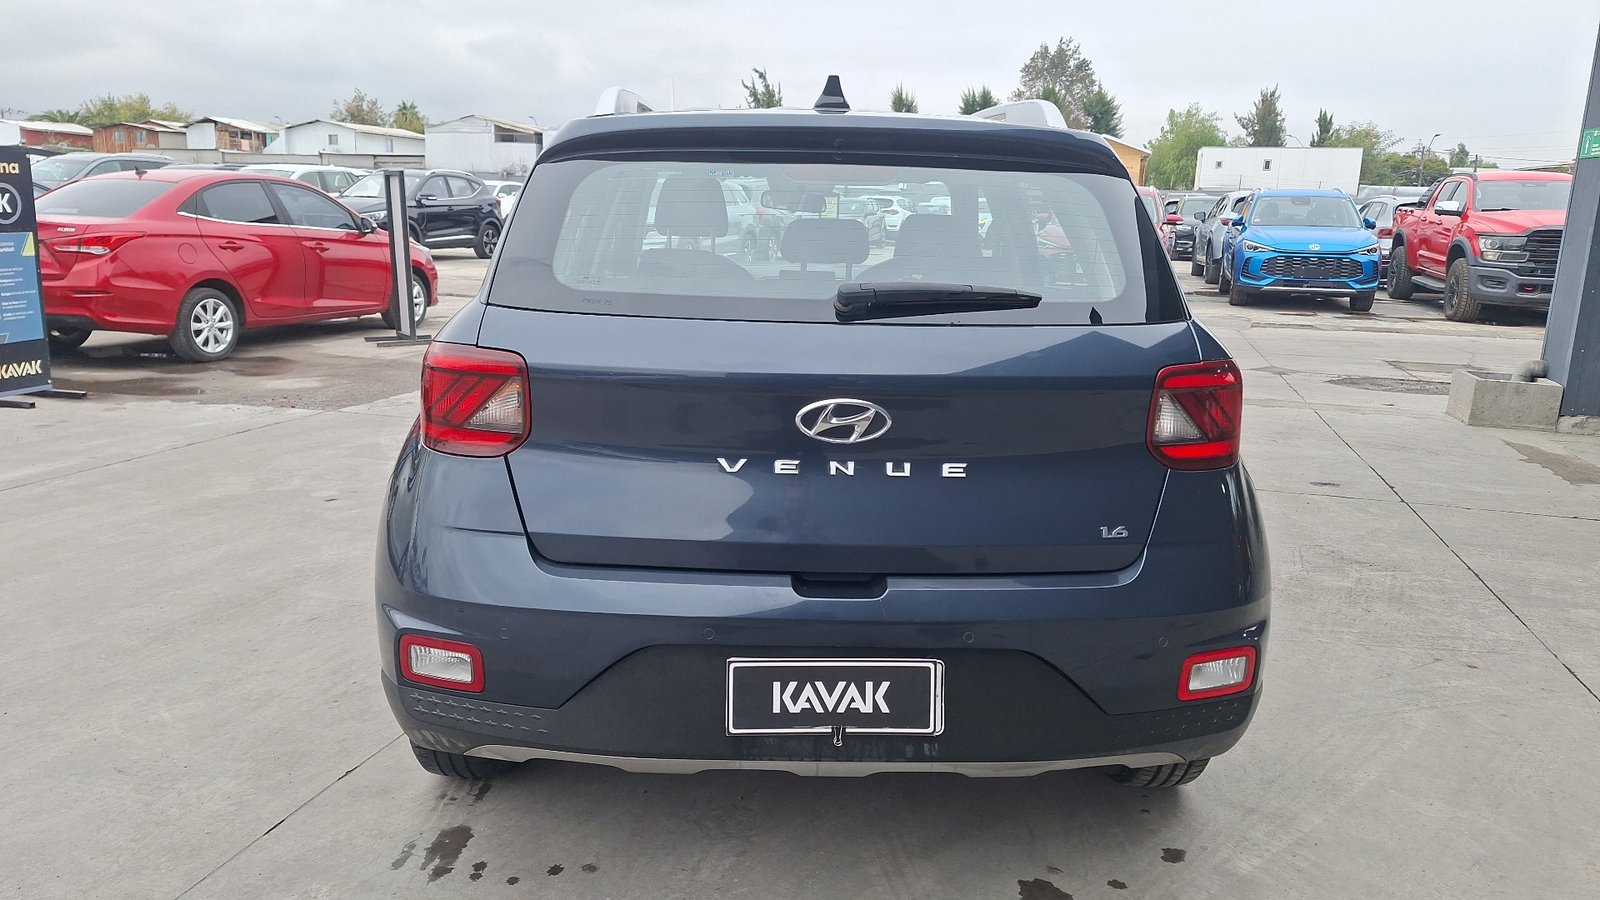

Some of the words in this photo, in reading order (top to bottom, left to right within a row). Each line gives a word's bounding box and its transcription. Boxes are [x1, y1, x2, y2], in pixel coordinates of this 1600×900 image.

[0, 193, 13, 213] K
[0, 360, 42, 379] KAVAK
[716, 457, 968, 478] VENUE
[772, 681, 891, 714] KAVAK
